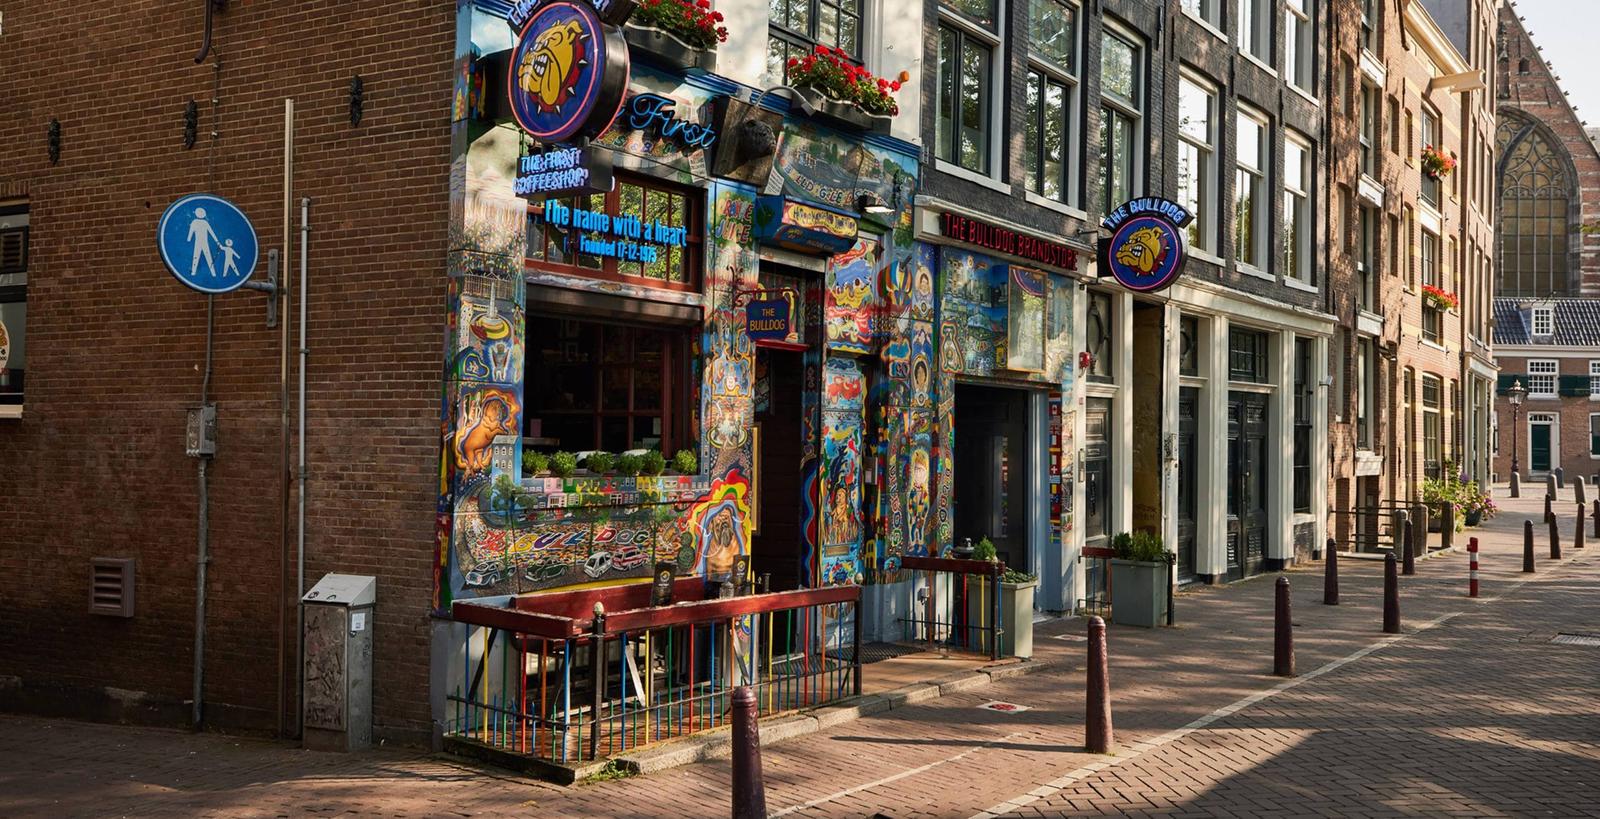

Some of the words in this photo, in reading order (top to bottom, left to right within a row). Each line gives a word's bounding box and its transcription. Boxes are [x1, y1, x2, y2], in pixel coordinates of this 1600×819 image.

[630, 94, 716, 148] First
[1104, 206, 1129, 227] THE
[1129, 198, 1186, 225] BULLDOG
[572, 208, 610, 233] name
[612, 214, 641, 239] with
[643, 222, 652, 241] a
[654, 218, 688, 247] heart
[944, 212, 966, 240] THE
[967, 220, 1015, 254] BULLDOG
[579, 235, 616, 257] Founded
[749, 319, 785, 331] BULLDOG
[760, 308, 775, 317] THE
